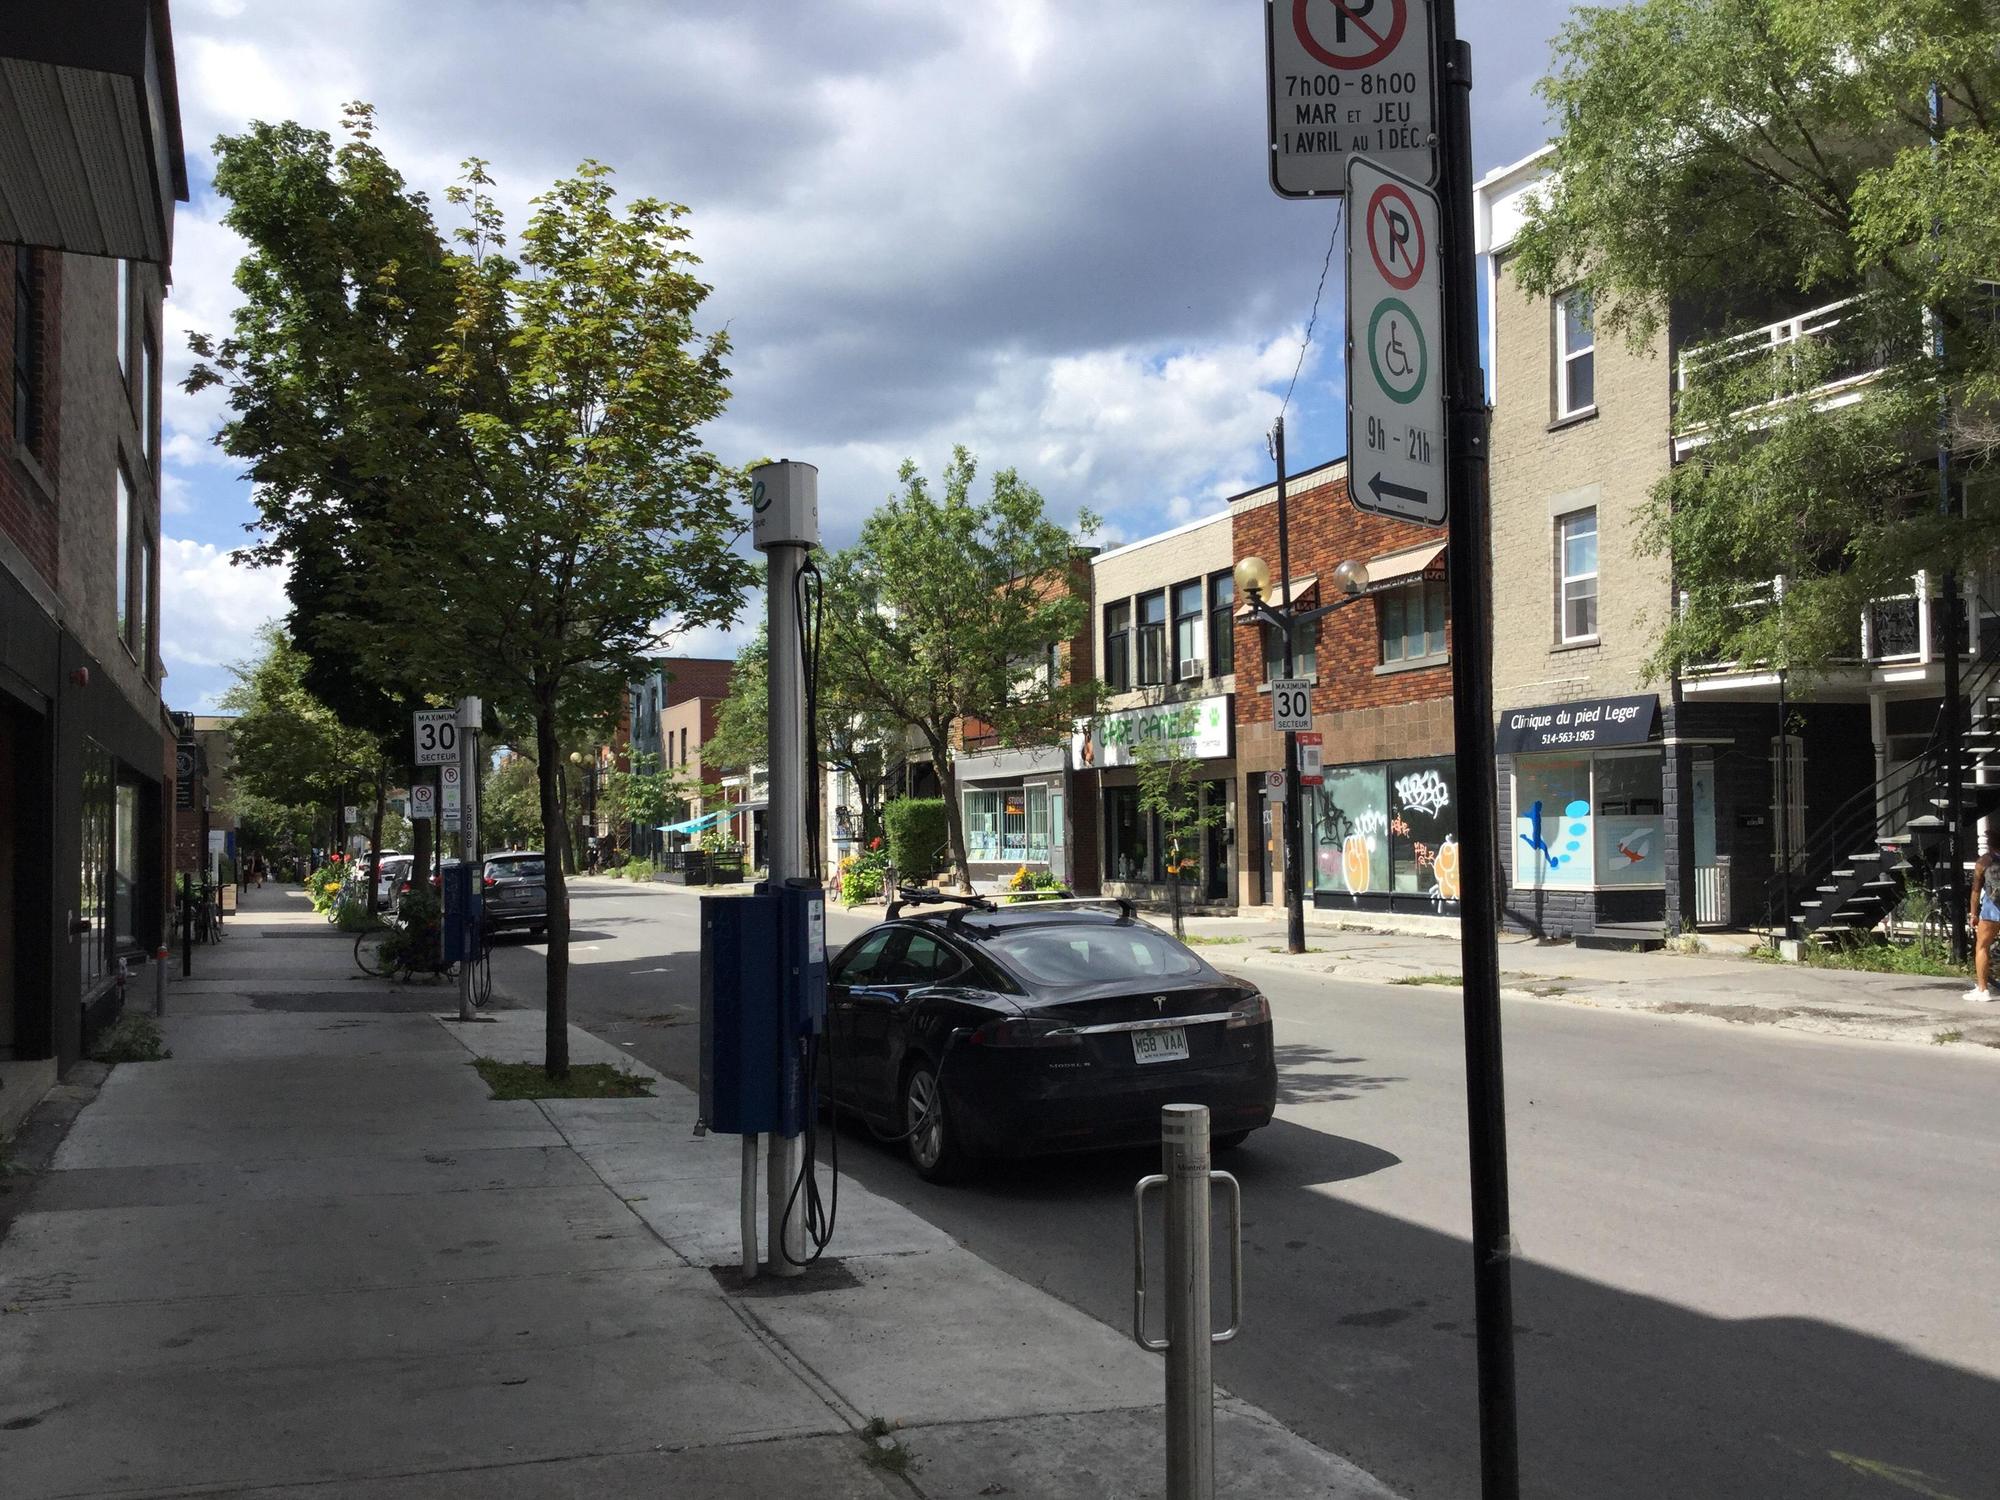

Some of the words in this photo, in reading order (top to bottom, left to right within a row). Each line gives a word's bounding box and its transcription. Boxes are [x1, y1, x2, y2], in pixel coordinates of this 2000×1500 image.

[1296, 103, 1337, 125] MAR
[1347, 110, 1361, 124] ET
[1373, 102, 1410, 123] JEU
[1297, 131, 1342, 153] AVRIL
[1352, 136, 1368, 151] AU
[1368, 415, 1385, 451] 9h
[1409, 428, 1431, 463] 21h
[1275, 682, 1307, 690] MAXIMUM
[1278, 691, 1307, 718] 30
[418, 713, 456, 722] MAXIMUM
[1278, 720, 1309, 728] SECTEUR
[1511, 714, 1552, 730] Clinique
[1556, 710, 1570, 725] du
[1575, 706, 1601, 727] pied
[1605, 705, 1640, 723] Leger
[420, 722, 456, 751] 30
[1541, 729, 1595, 745] 514-563-1963
[421, 753, 457, 762] SECTEUR
[1162, 1034, 1184, 1051] VAA
